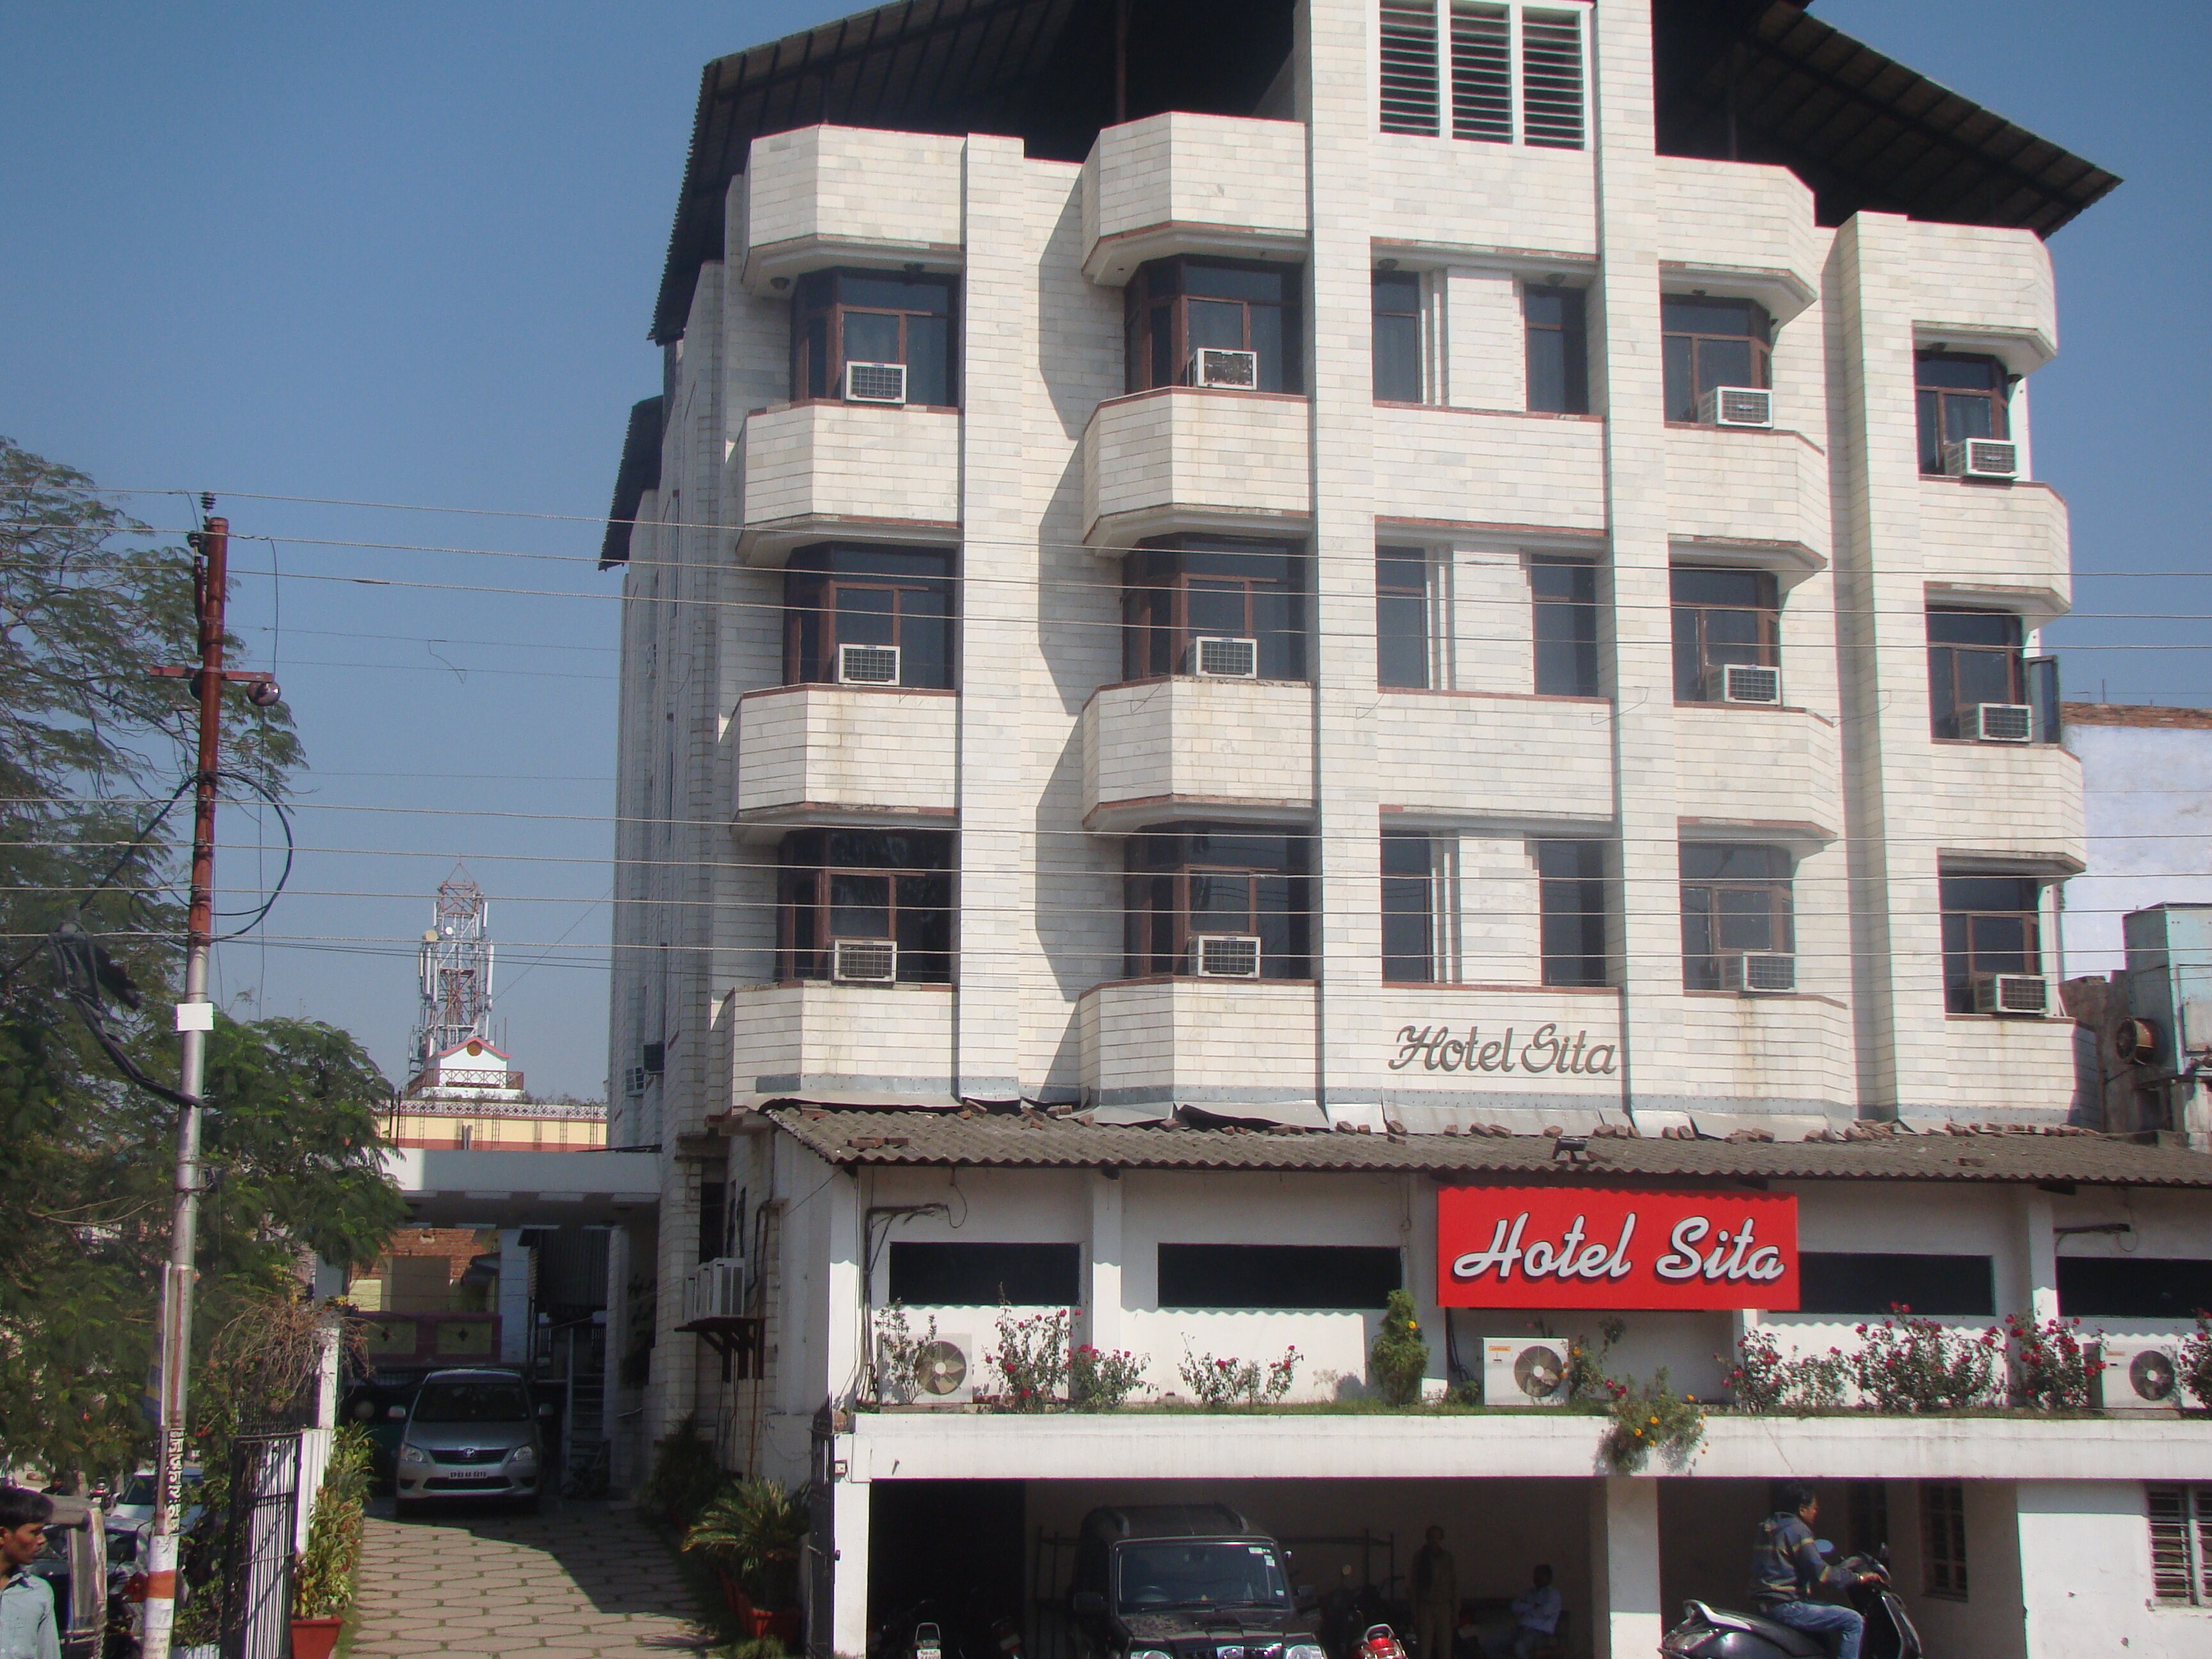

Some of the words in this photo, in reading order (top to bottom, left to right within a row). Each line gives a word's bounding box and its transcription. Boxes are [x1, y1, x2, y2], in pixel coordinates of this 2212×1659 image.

[1388, 1025, 1516, 1072] Hotel
[1520, 1022, 1617, 1075] Sita
[1452, 1211, 1637, 1279] Hotel
[1655, 1215, 1786, 1281] Sita
